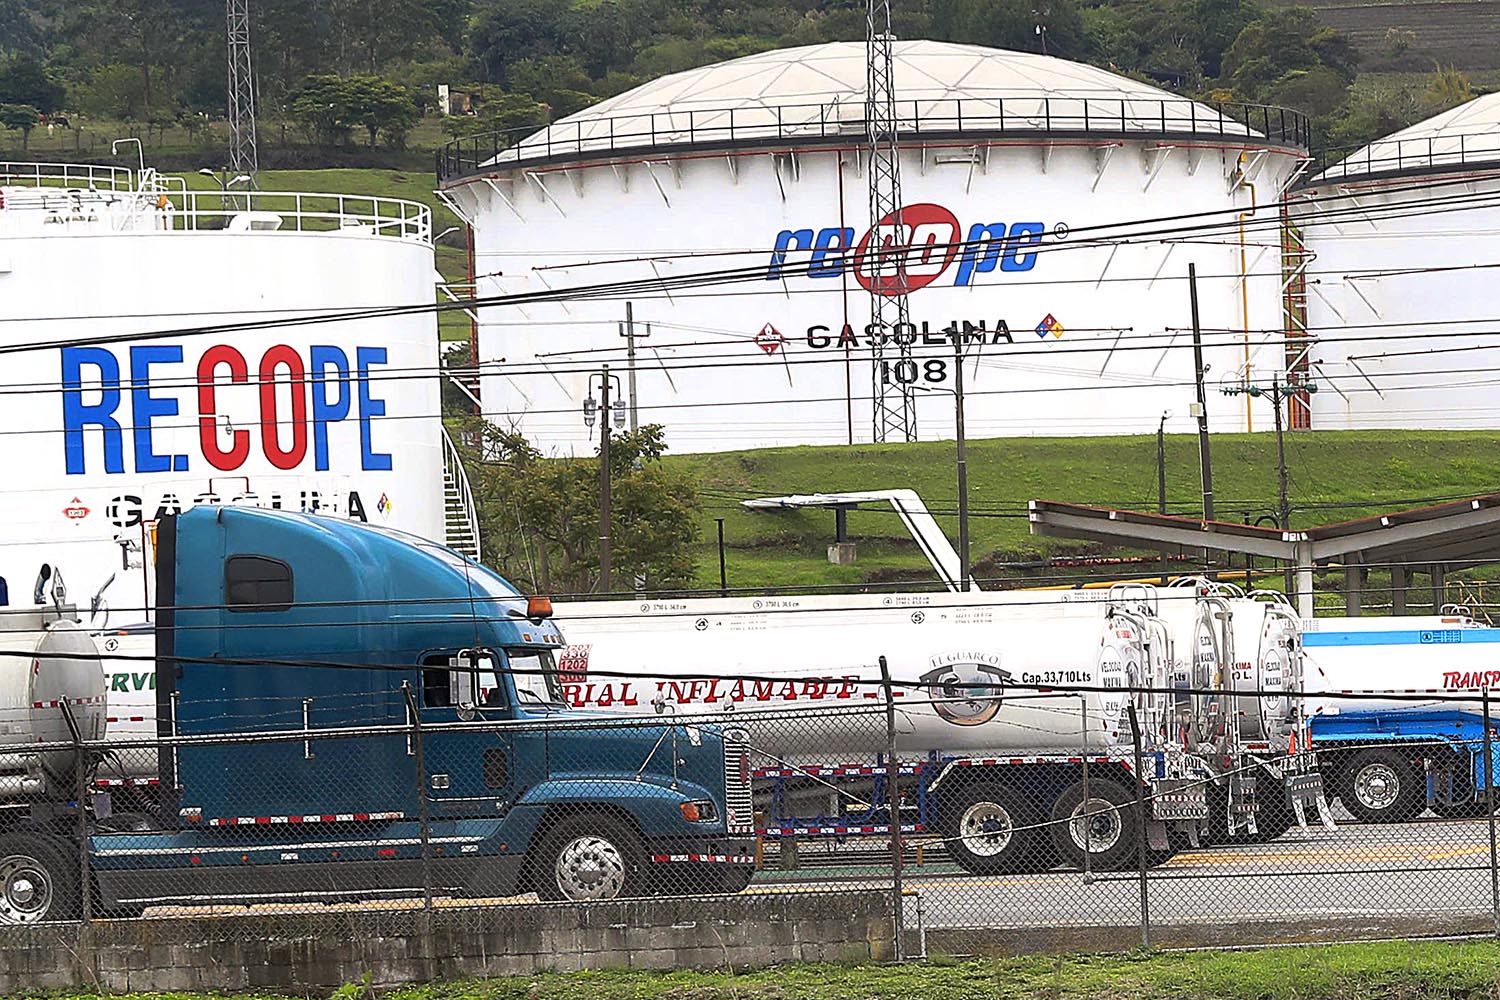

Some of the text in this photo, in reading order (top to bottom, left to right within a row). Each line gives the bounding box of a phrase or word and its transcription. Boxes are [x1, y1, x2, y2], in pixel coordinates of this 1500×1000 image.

[806, 319, 1014, 350] GASOLINA
[882, 359, 948, 385] 108
[61, 344, 393, 475] RECOPE
[561, 660, 586, 670] 1202
[947, 652, 999, 666] GUARCO
[653, 675, 861, 704] INFLAMABLE
